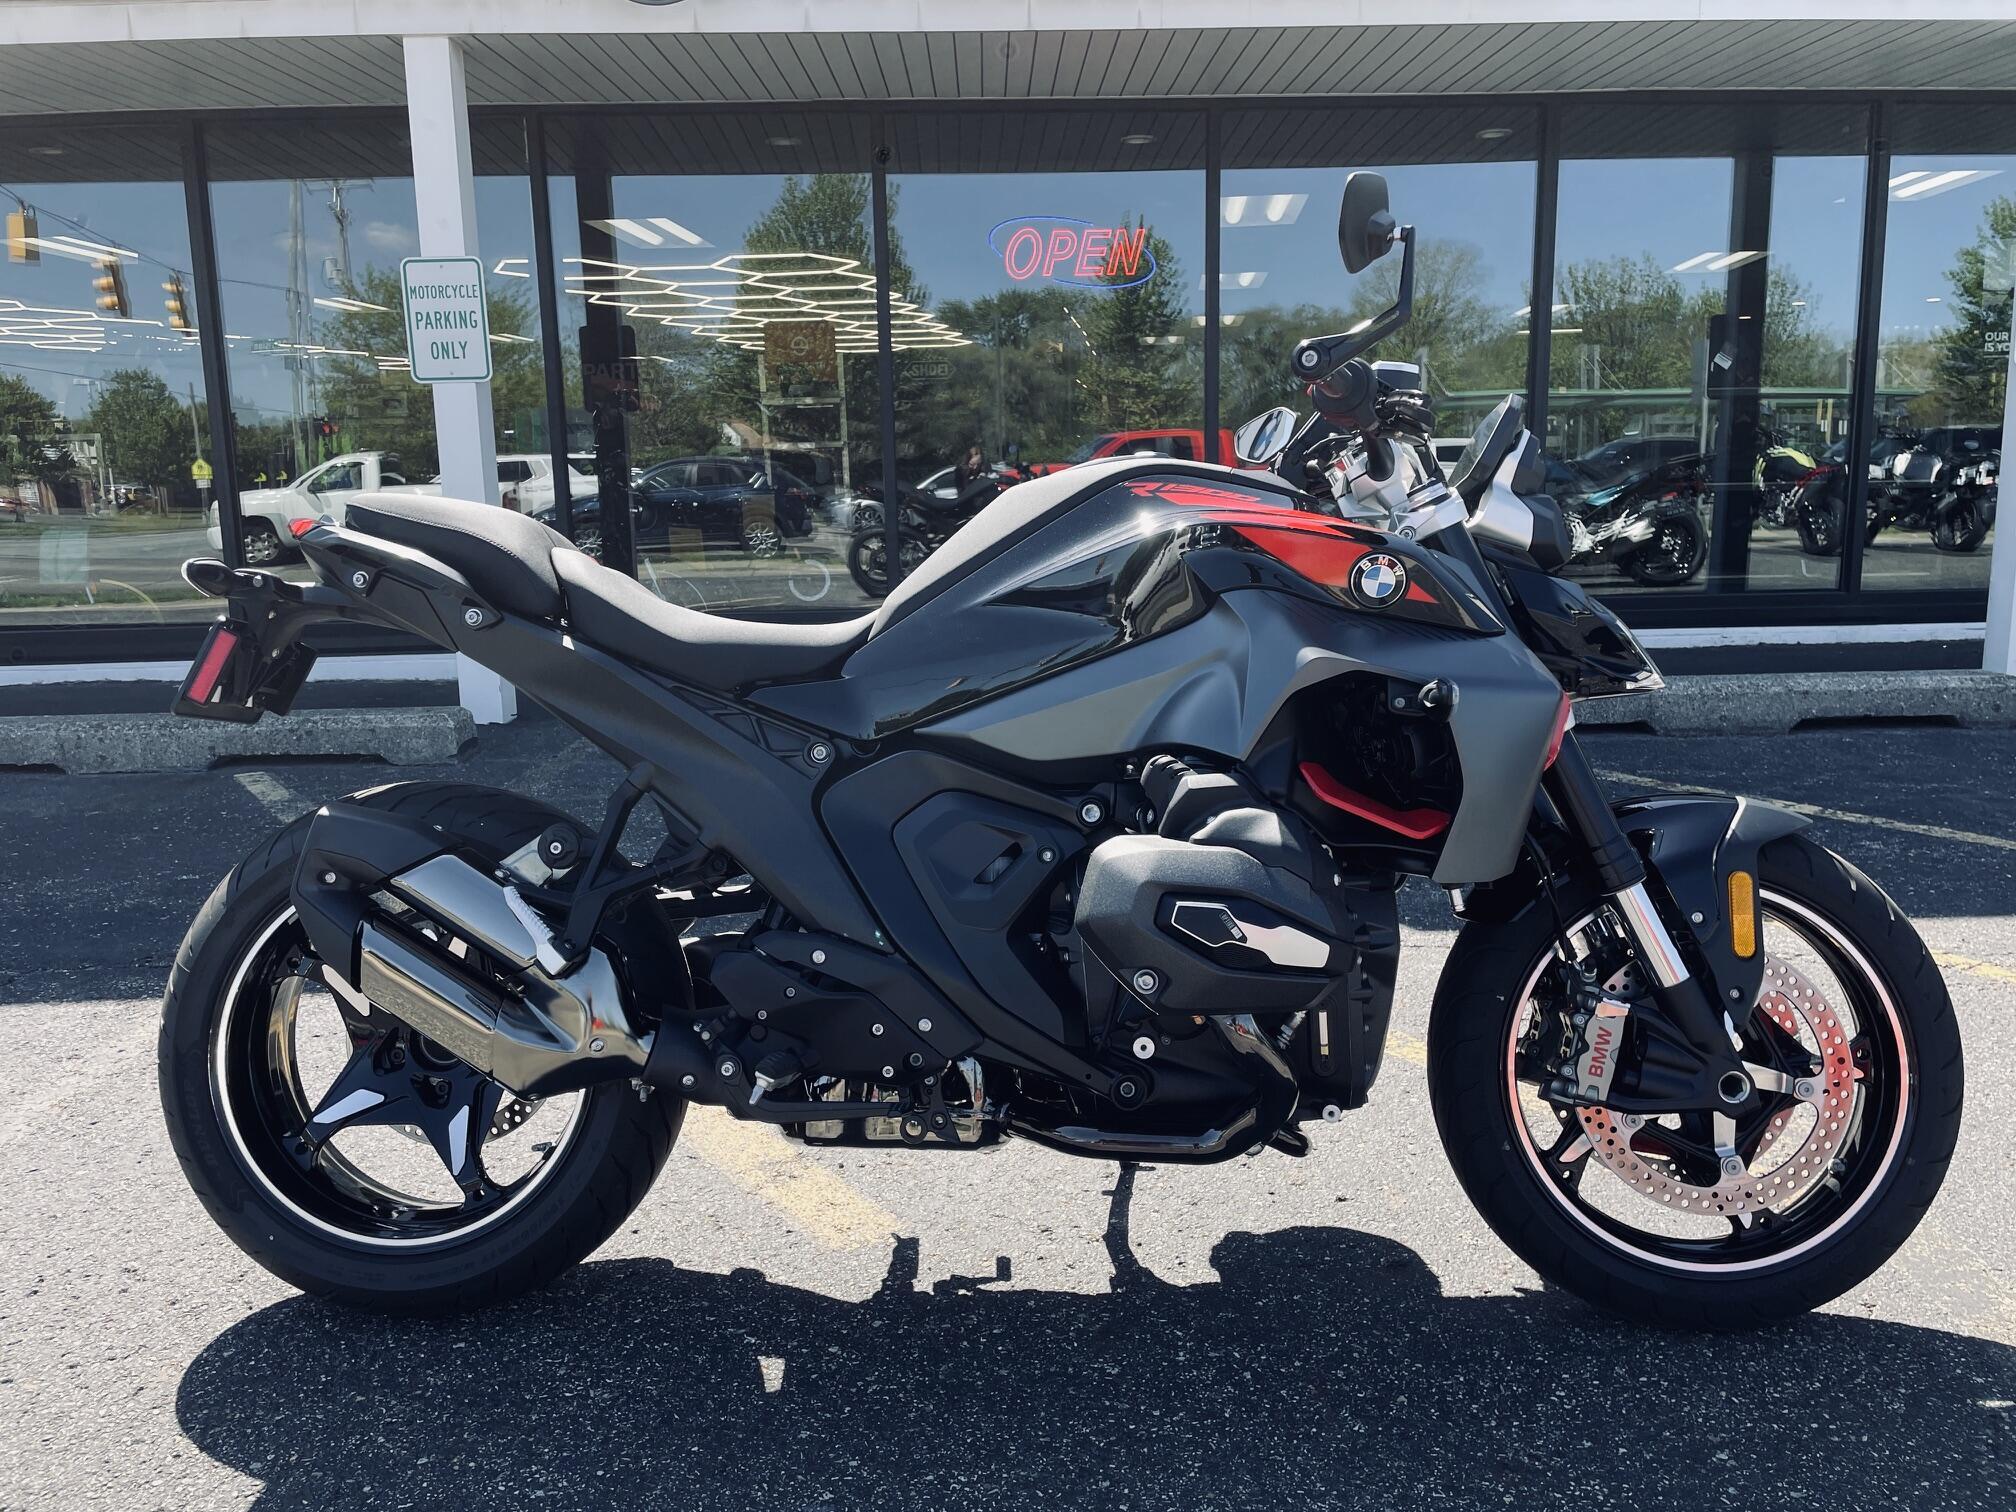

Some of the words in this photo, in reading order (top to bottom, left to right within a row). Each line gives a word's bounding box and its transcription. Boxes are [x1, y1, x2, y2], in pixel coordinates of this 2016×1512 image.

[1005, 227, 1146, 280] OPEN
[409, 284, 479, 299] MOTORCYCLE
[415, 310, 478, 330] PARKING
[1985, 331, 2009, 341] OUR
[430, 341, 468, 360] ONLY
[1984, 342, 1995, 352] IS
[582, 362, 654, 379] PART
[1359, 555, 1404, 577] BMW
[1588, 1026, 1613, 1078] BMW
